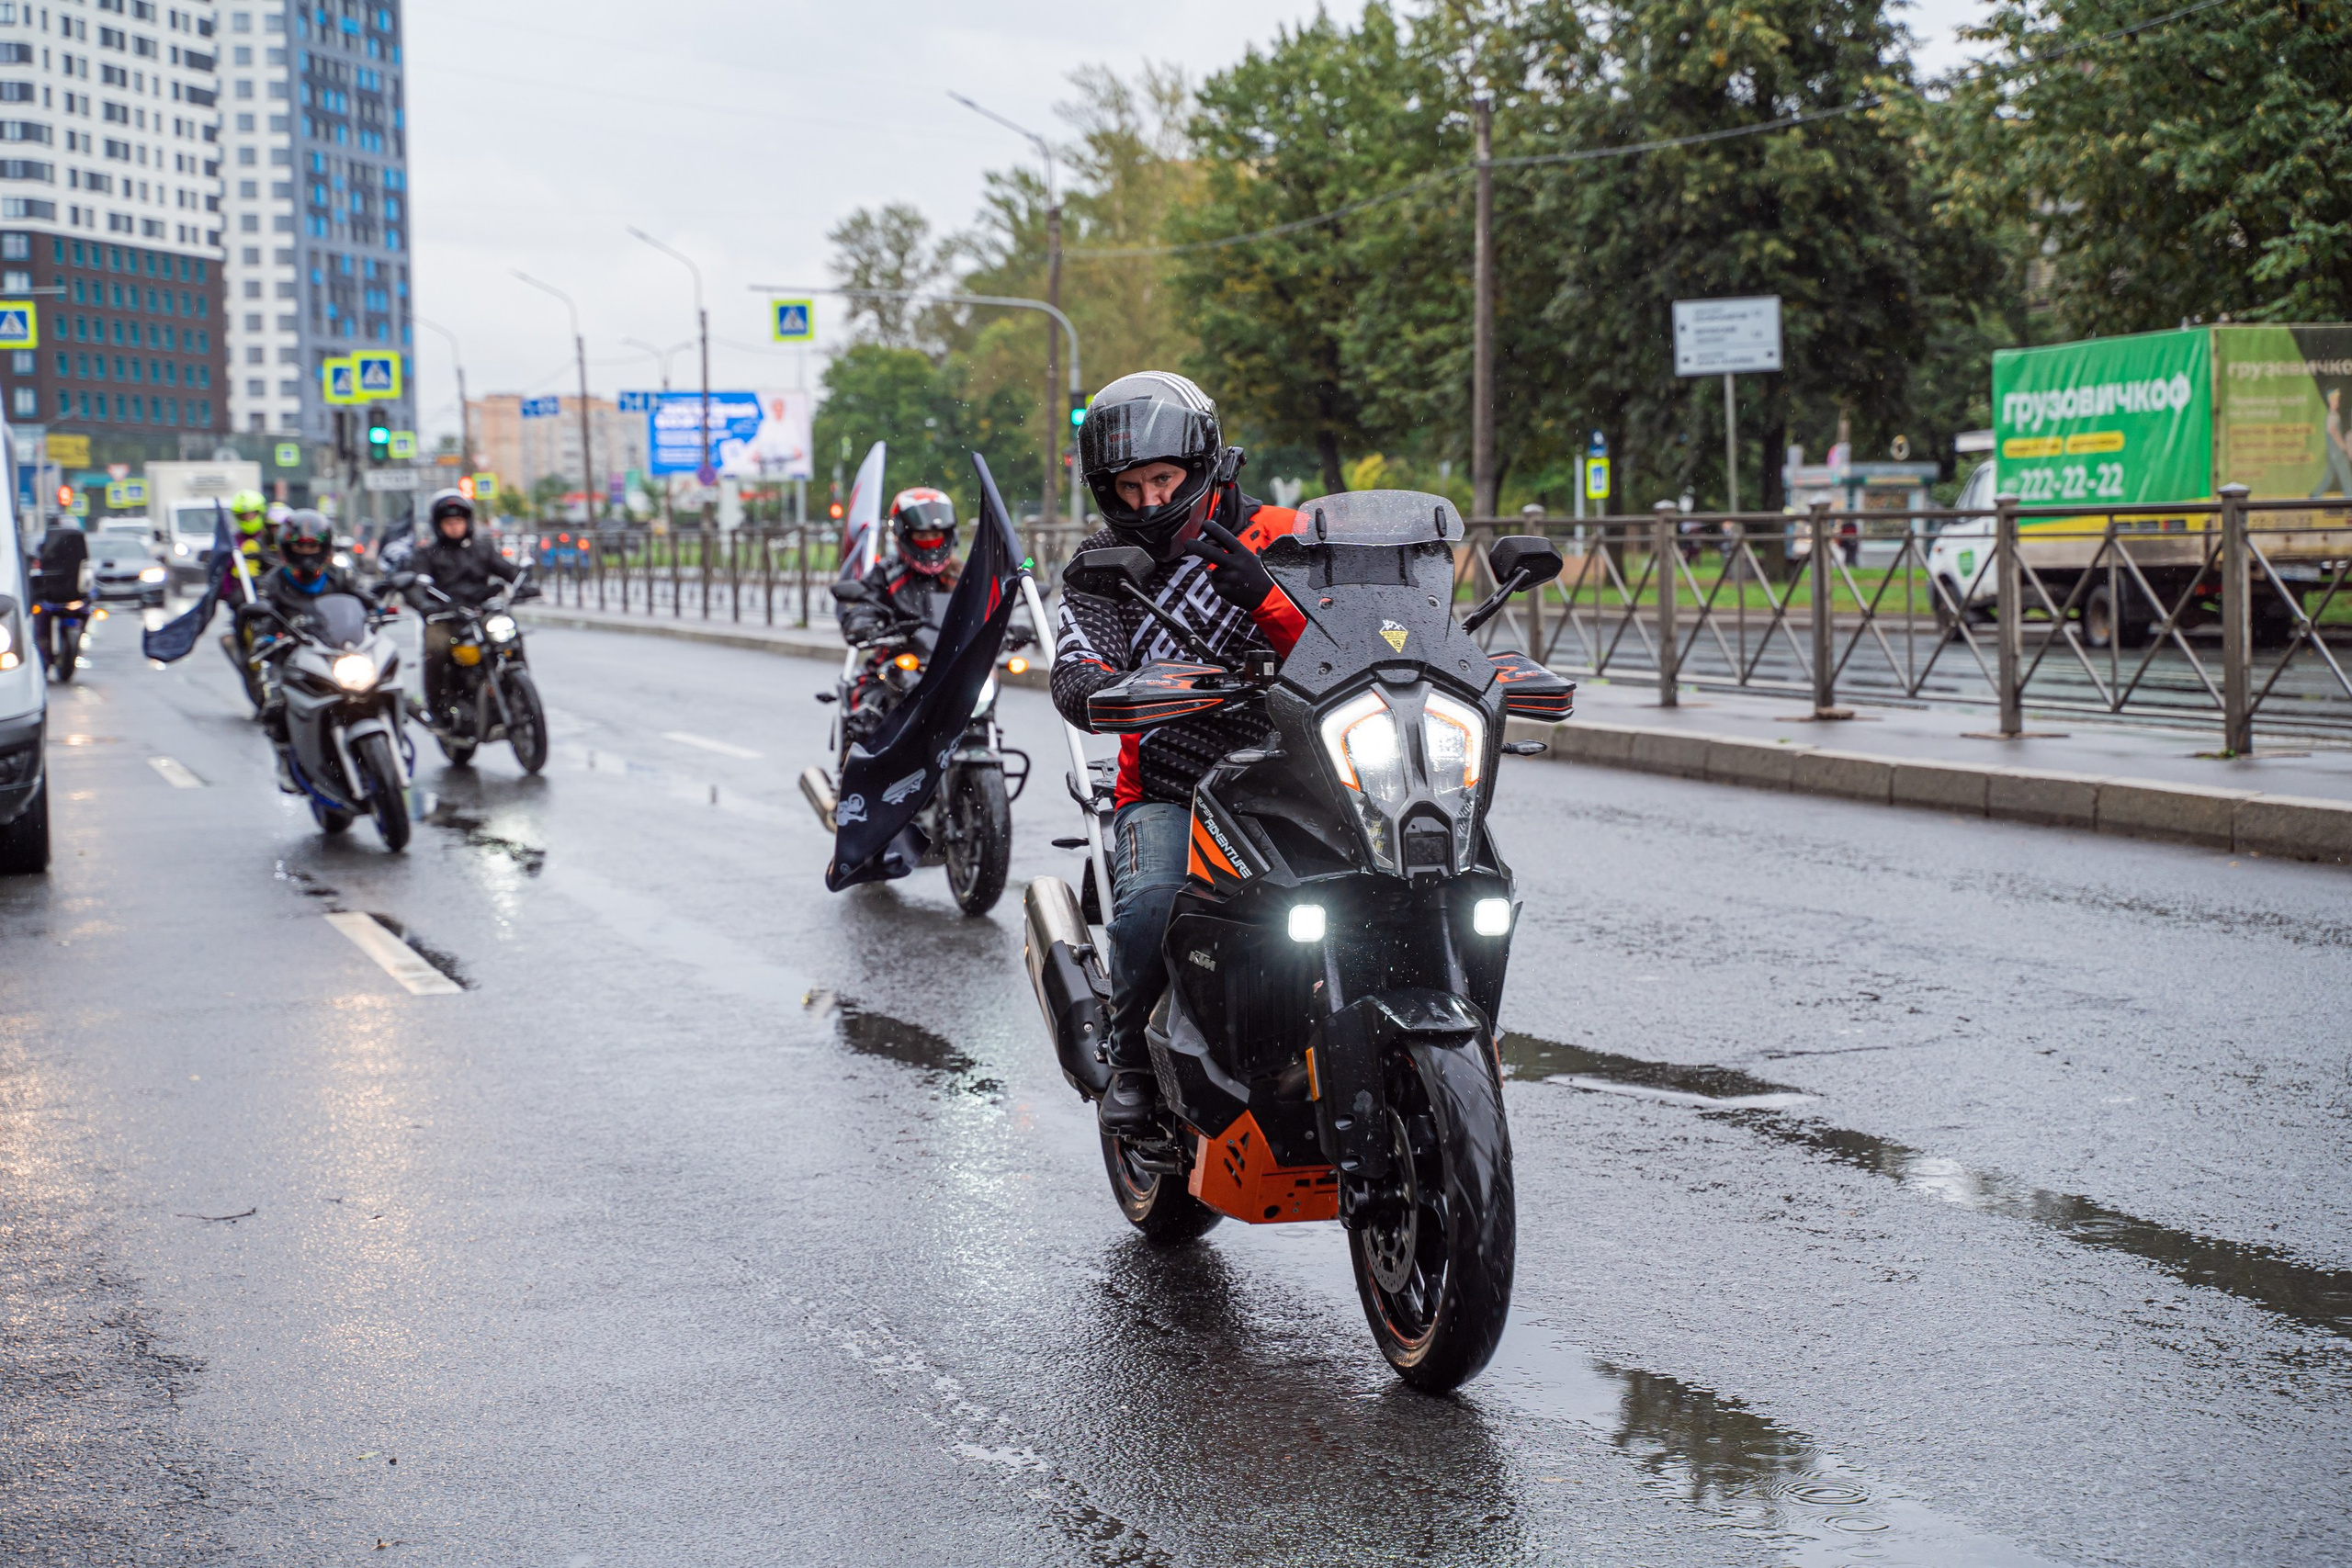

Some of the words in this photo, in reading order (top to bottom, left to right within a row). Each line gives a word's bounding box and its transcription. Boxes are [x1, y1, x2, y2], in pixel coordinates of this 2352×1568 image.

[1196, 795, 1215, 819] SUPER
[1204, 818, 1253, 879] ADVENTURE
[1188, 950, 1216, 972] KTM
